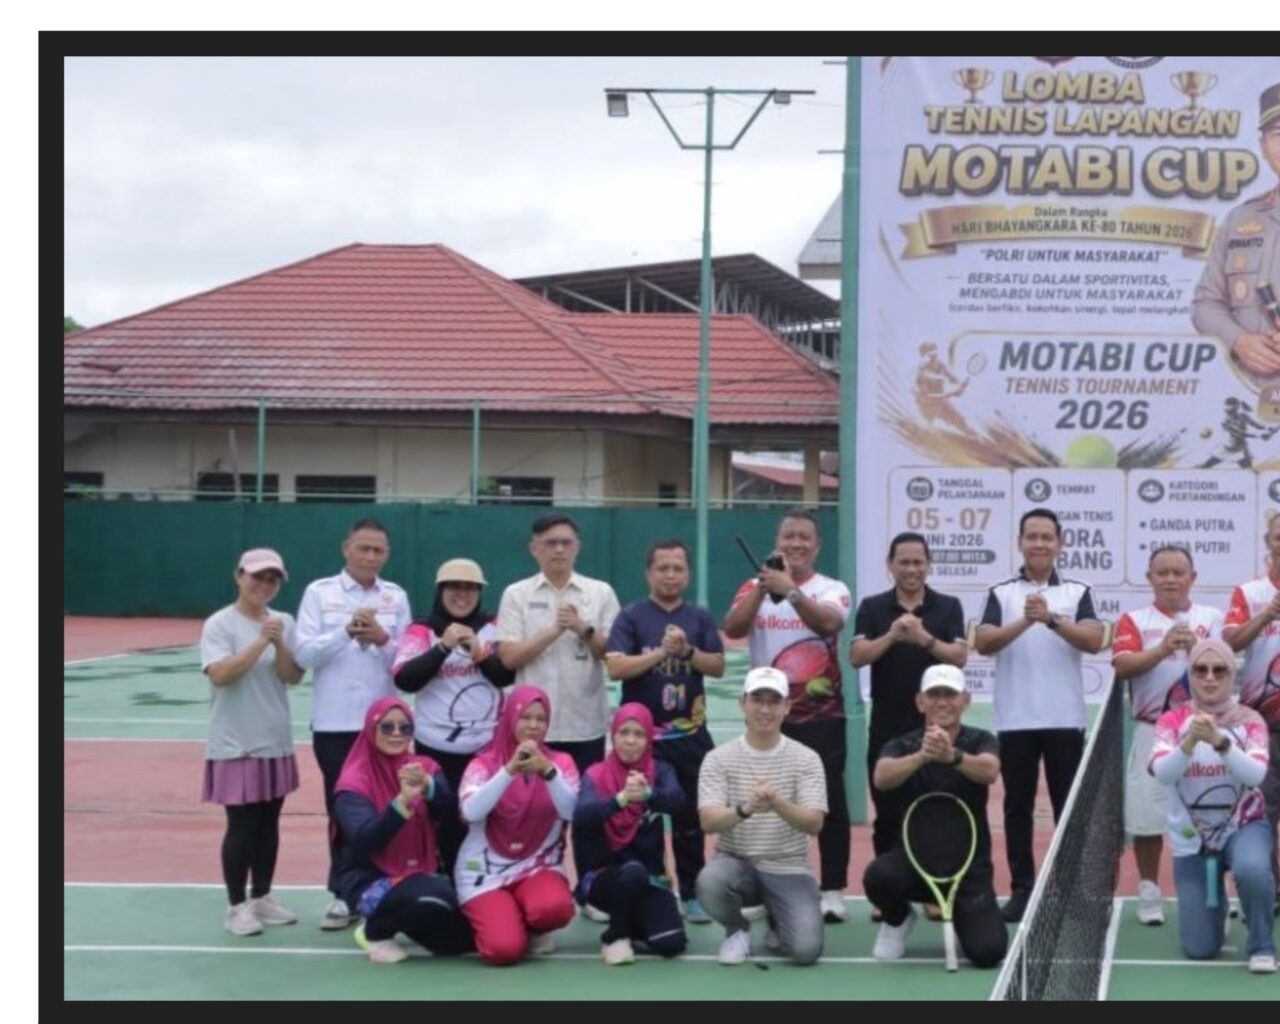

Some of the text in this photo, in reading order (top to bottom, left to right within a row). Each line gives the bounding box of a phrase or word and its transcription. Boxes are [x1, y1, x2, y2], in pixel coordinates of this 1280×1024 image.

[1002, 70, 1145, 103] LOMBA
[924, 104, 1241, 138] TENNIS LAPANGAN
[899, 143, 1260, 200] MOTABI CUP
[1034, 206, 1108, 219] Dalam Rangka
[952, 221, 982, 234] HARI
[985, 219, 1078, 233] BHAYANGKARA
[1120, 220, 1162, 235] TAHUN
[1165, 223, 1194, 239] 2026
[1027, 249, 1071, 262] UNTUK
[967, 272, 1171, 287] BERSATU DALAM SPORTIVITAS,
[959, 287, 1184, 301] MENGABDI UNTUK MASYARAKAT
[998, 341, 1217, 372] MOTABI CUP
[1005, 377, 1200, 395] TENNIS TOURNAMENT
[1055, 399, 1150, 430] 2026
[938, 478, 984, 488] TANGGAL
[1057, 484, 1096, 495] TEMPAT
[1168, 480, 1218, 491] KATEGORI
[938, 490, 1005, 499] PELAKSANAAN
[1168, 492, 1246, 502] PERTANDINGAN
[906, 507, 940, 531] 05
[960, 507, 992, 531] 07
[1083, 511, 1114, 522] TENIS
[1150, 518, 1235, 532] GANDA PUTRA
[926, 533, 984, 547] UNI 2026
[1063, 528, 1106, 548] ORA
[1195, 541, 1230, 553] PUTRI
[961, 551, 987, 562] WITA
[1057, 550, 1114, 571] BANG
[937, 565, 978, 576] SELESAI
[756, 615, 804, 630] elkom
